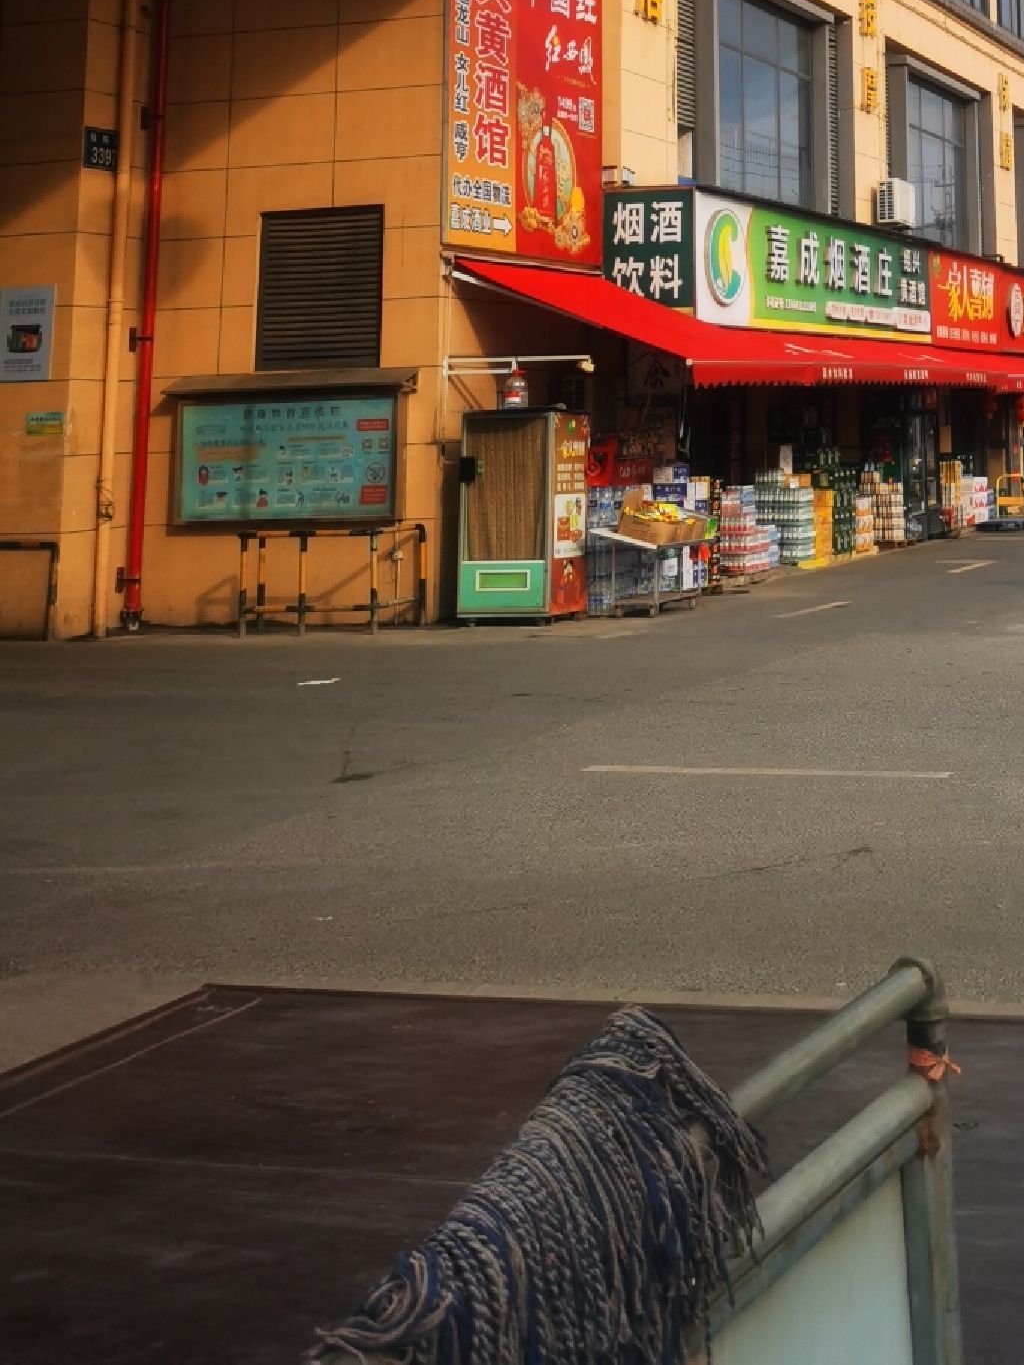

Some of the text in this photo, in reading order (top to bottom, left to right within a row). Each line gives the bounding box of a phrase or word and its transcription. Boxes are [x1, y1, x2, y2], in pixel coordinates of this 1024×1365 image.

[451, 172, 512, 207] 代办全国物流
[613, 201, 684, 245] 烟酒
[613, 253, 683, 300] 饮料
[766, 224, 893, 297] 嘉成烟酒庄
